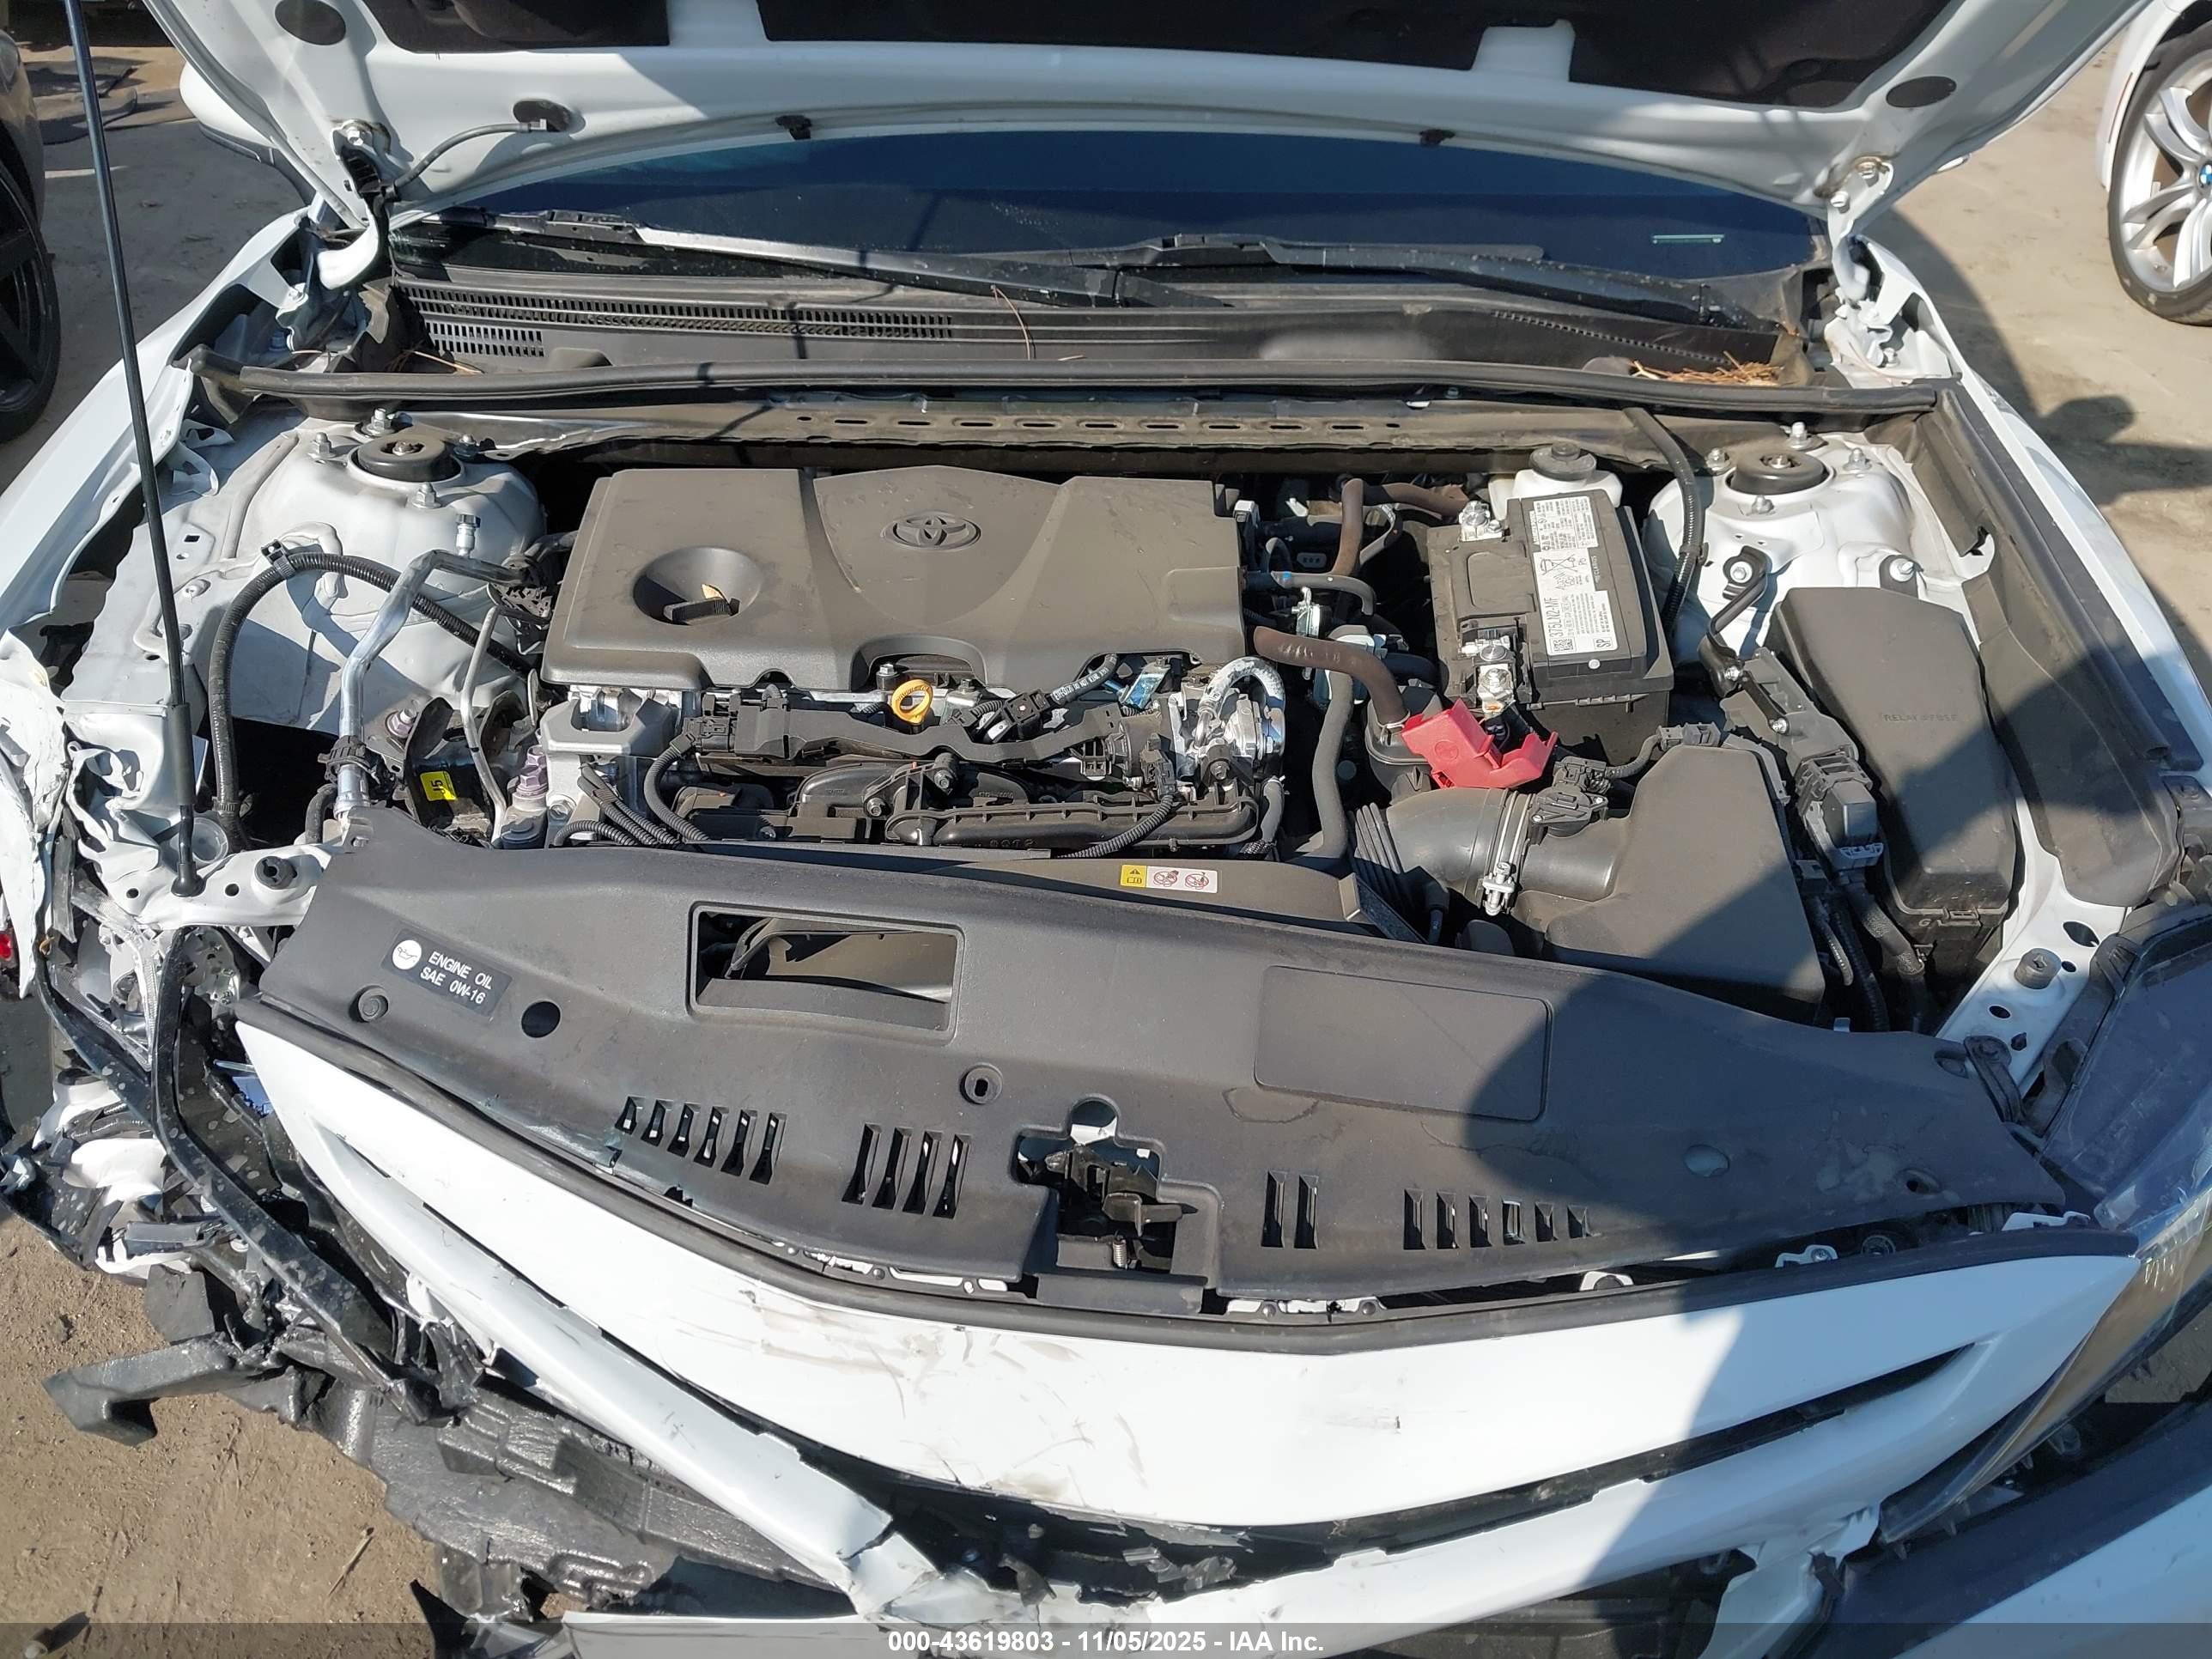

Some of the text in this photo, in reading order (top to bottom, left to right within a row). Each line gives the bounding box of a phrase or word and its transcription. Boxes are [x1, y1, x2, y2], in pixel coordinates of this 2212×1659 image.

[1596, 639, 1612, 648] SP
[420, 967, 486, 1004] SAE 0W-16
[428, 951, 493, 990] ENGINE OIL
